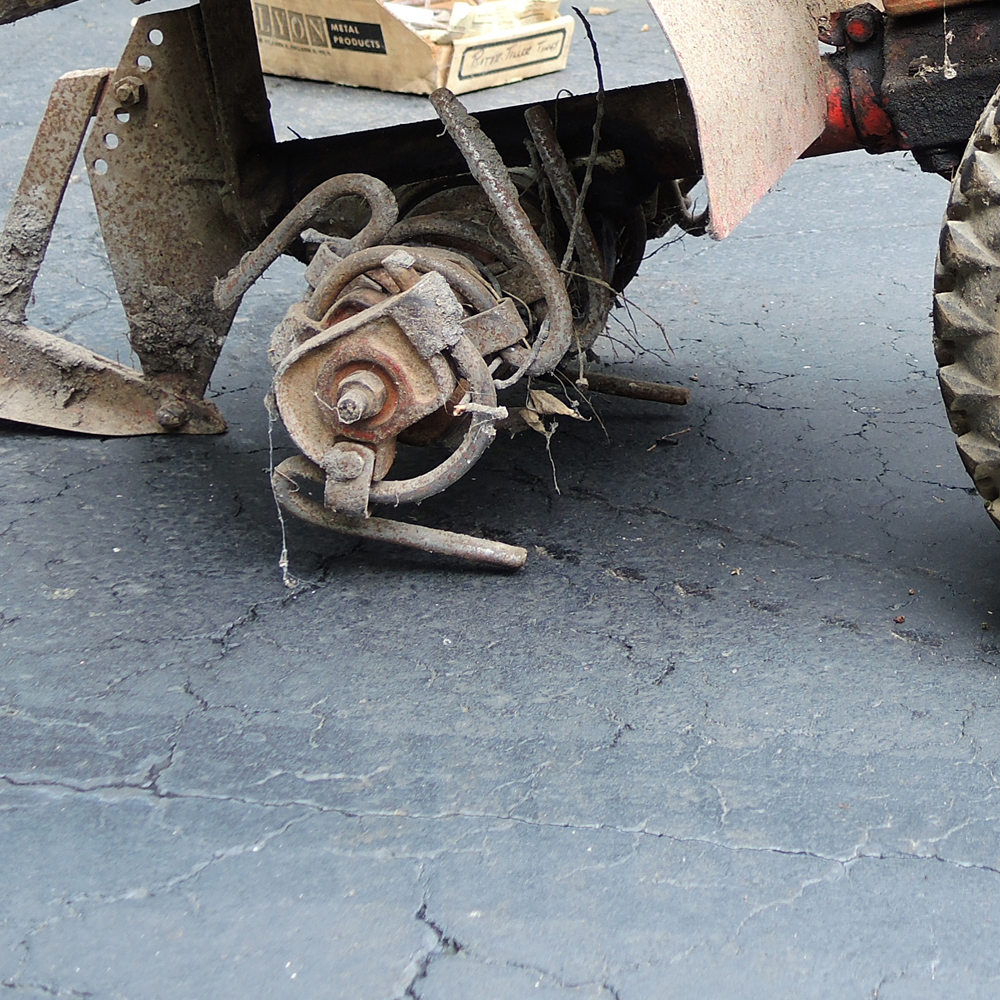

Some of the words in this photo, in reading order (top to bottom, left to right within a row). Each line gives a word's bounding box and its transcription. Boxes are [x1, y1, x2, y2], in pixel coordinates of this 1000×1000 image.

[255, 5, 326, 44] LYON
[330, 22, 360, 35] METAL
[333, 35, 381, 50] PRODUCTS
